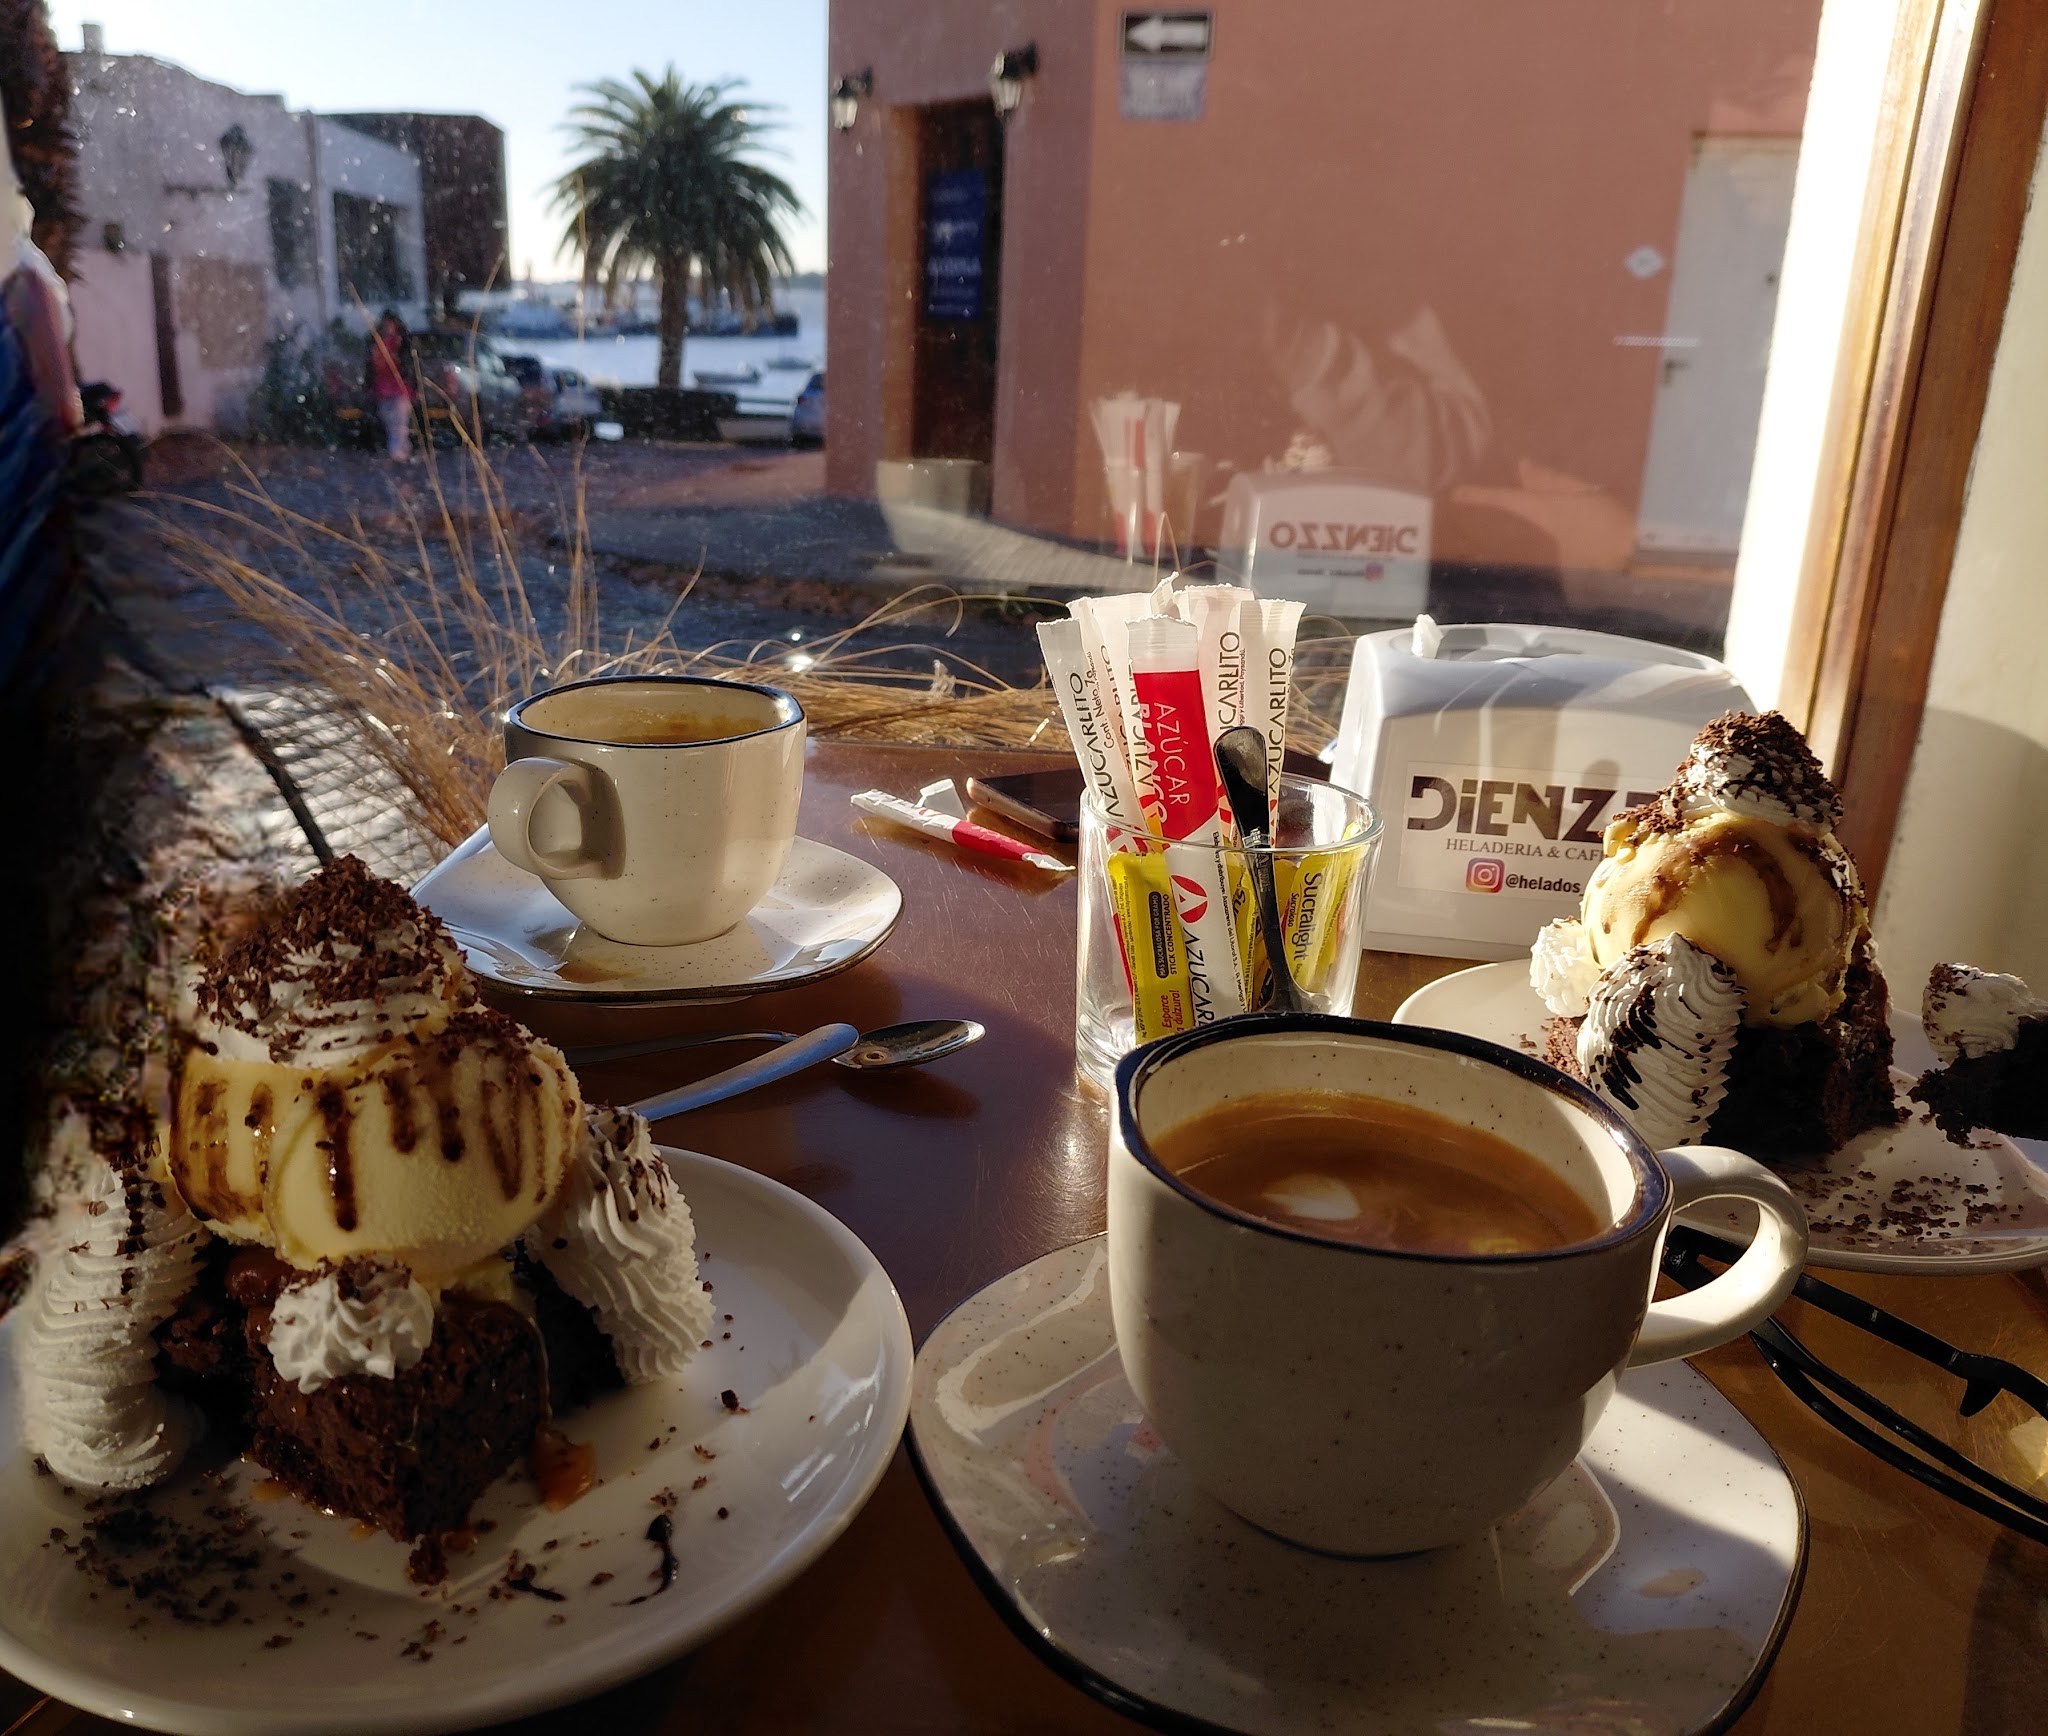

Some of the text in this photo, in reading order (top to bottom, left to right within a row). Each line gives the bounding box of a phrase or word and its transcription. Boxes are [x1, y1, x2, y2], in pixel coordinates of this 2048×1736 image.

[1092, 688, 1105, 718] Neto
[1268, 647, 1287, 794] AZUCARLITO
[1069, 672, 1125, 818] AZUCARLITO
[1100, 717, 1115, 750] Cont.
[1154, 702, 1190, 806] AZÚCAR
[1446, 838, 1543, 857] HELADERIA
[1547, 846, 1560, 858] &
[1162, 894, 1178, 975] STICK CONCENTRADO
[1291, 872, 1322, 961] Sucralight
[1161, 994, 1173, 1029] Esparce
[1169, 989, 1184, 1025] dulzura!
